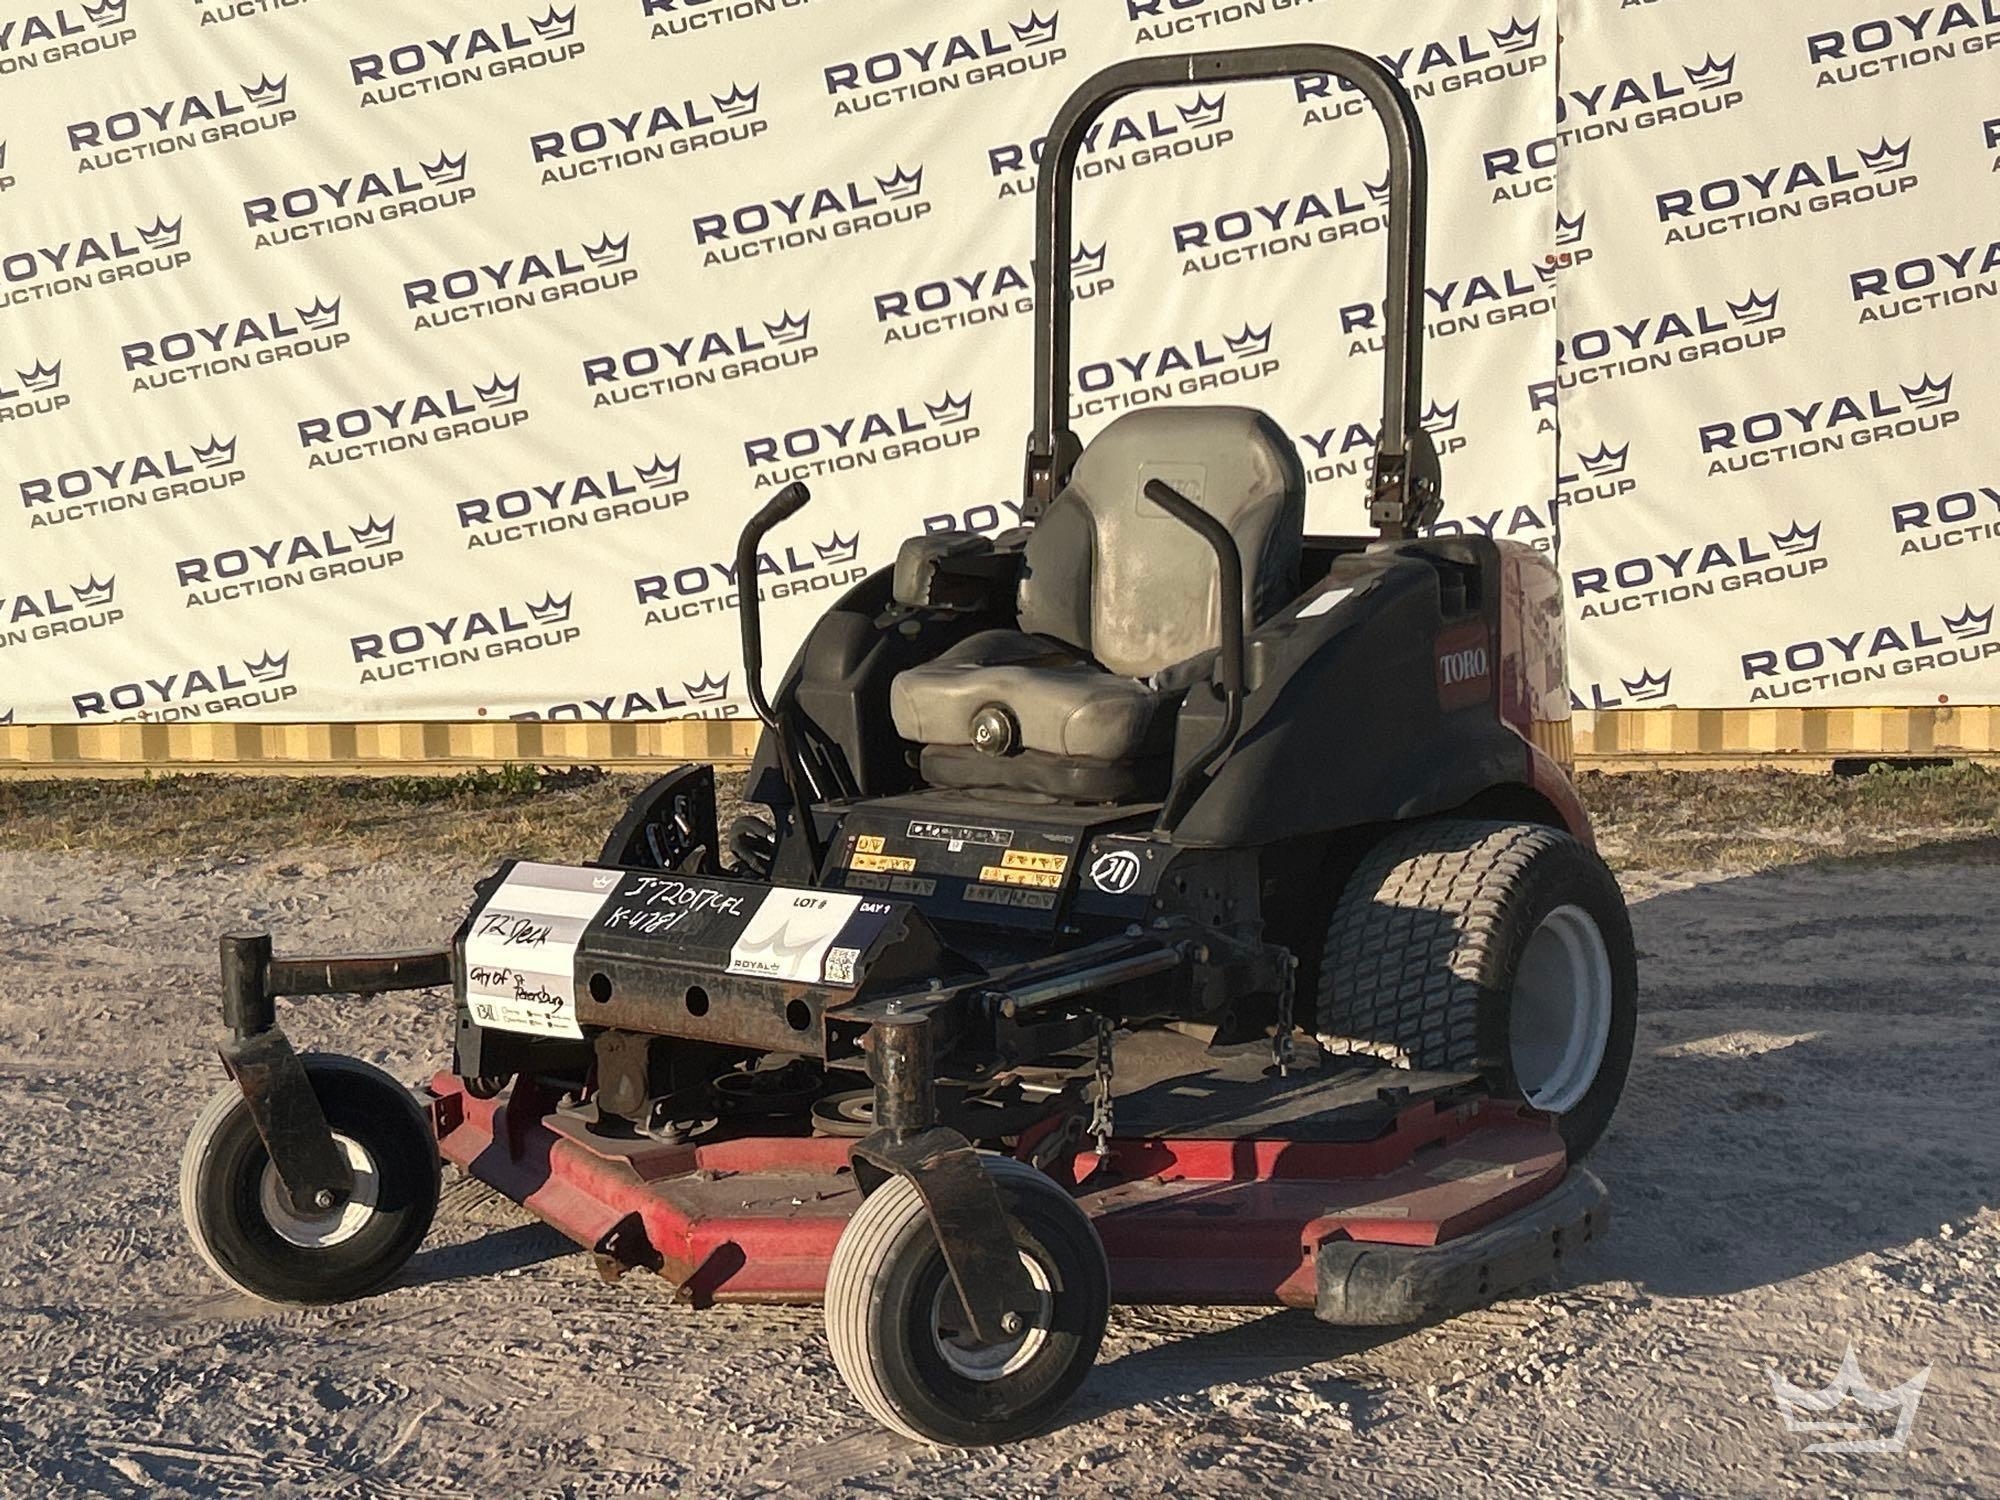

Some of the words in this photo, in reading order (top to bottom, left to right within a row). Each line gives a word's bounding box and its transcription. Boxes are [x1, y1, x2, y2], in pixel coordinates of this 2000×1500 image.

[0, 9, 85, 52] YAL
[43, 28, 137, 64] GROUP
[650, 0, 776, 40] AUCTION
[1135, 0, 1266, 45] AUCTION
[1806, 0, 2000, 65] ROYAL
[349, 22, 533, 86] ROYAL
[360, 65, 483, 108] AUCTION
[487, 42, 585, 78] GROUP
[823, 28, 1012, 95] ROYAL
[834, 73, 960, 118] AUCTION
[965, 47, 1067, 85] GROUP
[1441, 54, 1547, 93] GROUP
[1816, 42, 1956, 89] AUCTION
[66, 89, 245, 152] ROYAL
[1556, 70, 1686, 125] YAL
[1556, 116, 1629, 148] TION
[1634, 91, 1744, 129] GROUP
[78, 132, 197, 174] AUCTION
[201, 109, 297, 144] GROUP
[529, 99, 715, 164] ROYAL
[541, 143, 665, 186] AUCTION
[669, 119, 768, 156] GROUP
[998, 155, 1126, 199] AUION
[1131, 129, 1234, 167] GROUP
[1655, 155, 1860, 223] ROYAL
[243, 166, 424, 228] ROYAL
[255, 209, 375, 250] AUCTION
[379, 187, 476, 221] GROUP
[692, 181, 878, 246] ROYAL
[1172, 187, 1366, 254] ROYAL
[1664, 200, 1802, 246] AUCTION
[1808, 175, 1918, 213] GROUP
[0, 230, 140, 284] OYAL
[703, 225, 827, 268] AUCTION
[832, 201, 932, 237] GROUP
[1182, 232, 1312, 276] AUCTION
[1317, 213, 1390, 244] GRO
[0, 274, 93, 309] UCTION
[97, 251, 192, 285] GROUP
[403, 248, 586, 310] ROYAL
[414, 291, 536, 331] AUCTION
[540, 269, 638, 303] GROUP
[873, 259, 1037, 323] ROYA
[1338, 268, 1535, 335] RYAL
[1849, 241, 2000, 302] ROYA
[884, 302, 1009, 344] AUCTION
[1014, 278, 1115, 314] GUP
[1348, 314, 1481, 358] AUION
[1486, 296, 1557, 325] GRO
[1858, 280, 1998, 325] AUCTION
[121, 311, 299, 372] ROYAL
[133, 353, 251, 393] AUCTION
[256, 332, 350, 365] GROUP
[582, 326, 766, 387] ROYAL
[1072, 339, 1225, 395] OYAL
[1556, 351, 1671, 390] UCTION
[1678, 326, 1786, 363] GROUP
[593, 368, 716, 409] AUCTION
[721, 346, 819, 380] GROUP
[1068, 383, 1172, 420] UCTION
[1178, 359, 1280, 395] GROUP
[0, 394, 71, 423] ROUP
[297, 389, 477, 448] ROYAL
[308, 430, 428, 469] AUCTION
[433, 409, 529, 442] GROUP
[743, 407, 927, 468] ROYAL
[1698, 389, 1902, 454] ROYAL
[754, 448, 877, 489] AUCTION
[882, 426, 980, 461] GROUP
[1707, 434, 1844, 477] AUCTION
[1850, 410, 1960, 447] GROUP
[19, 450, 194, 508] ROYAL
[30, 491, 147, 529] AUCTION
[152, 470, 246, 502] GROUP
[456, 470, 637, 529] ROYAL
[1557, 478, 1637, 508] ROUP
[467, 511, 588, 550] AUCTION
[593, 490, 690, 523] GROUP
[1900, 521, 2000, 556] AUCTI
[175, 530, 352, 588] ROYAL
[186, 570, 305, 608] AUCTION
[309, 550, 404, 582] GROUP
[771, 566, 867, 599] GROUP
[1571, 536, 1771, 599] ROYAL
[1580, 579, 1715, 621] AUCTION
[1720, 557, 1828, 592] GROUP
[32, 609, 124, 640] GROUP
[350, 606, 529, 664] ROYAL
[1740, 620, 1944, 681] ROYAL
[360, 647, 480, 685] AUCTION
[485, 626, 581, 658] GROUP
[1440, 648, 1486, 685] TORO
[1749, 663, 1886, 703] AUCTION
[1892, 641, 2000, 676] GROUP
[71, 664, 247, 719] ROYAL
[204, 684, 298, 714] GROUP
[793, 897, 818, 909] LOT
[859, 903, 883, 915] DAY
[734, 959, 771, 971] ROYAL
